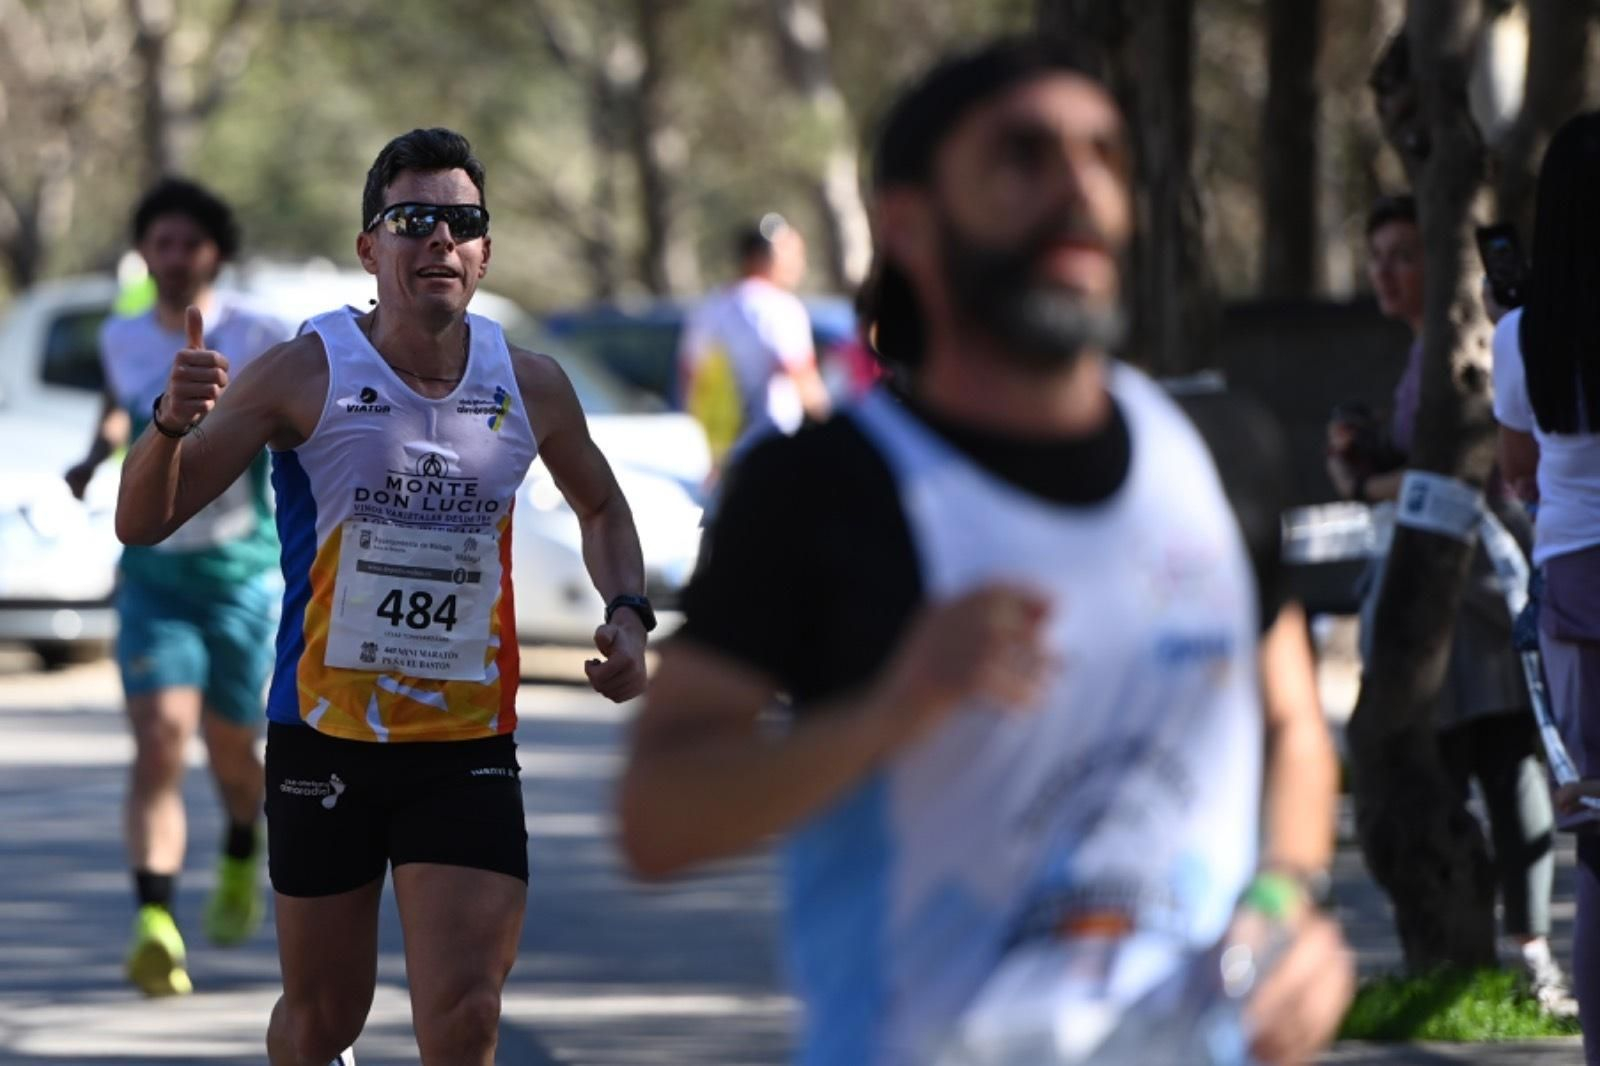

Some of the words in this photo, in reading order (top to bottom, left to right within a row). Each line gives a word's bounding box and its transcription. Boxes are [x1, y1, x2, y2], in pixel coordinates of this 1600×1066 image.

[347, 404, 391, 413] VIATOR
[386, 476, 478, 497] MONTE
[355, 488, 409, 509] DON
[422, 497, 499, 513] LUCIO
[376, 589, 458, 631] 484
[407, 660, 416, 668] EL
